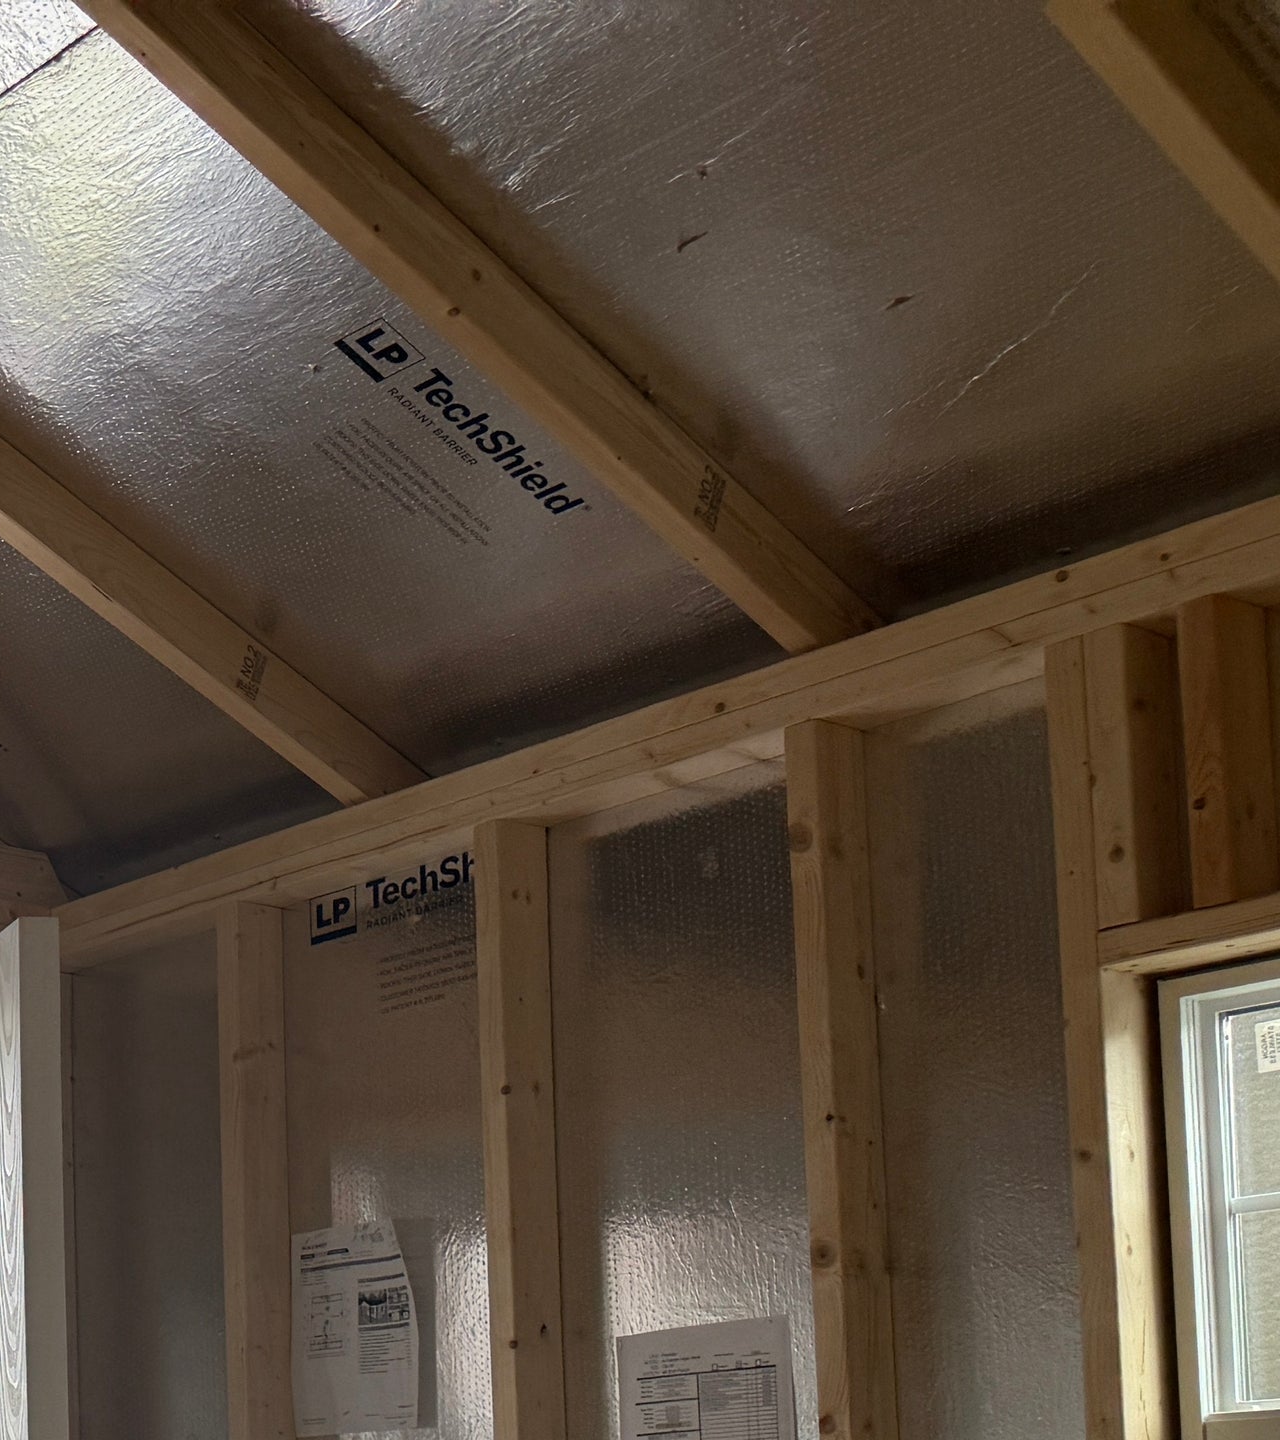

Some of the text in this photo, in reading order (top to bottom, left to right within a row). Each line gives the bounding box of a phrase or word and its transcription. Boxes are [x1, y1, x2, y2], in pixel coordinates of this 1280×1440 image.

[355, 327, 410, 367] LP
[413, 367, 585, 516] TechShield
[387, 386, 479, 466] RADIANT BARRIER
[315, 851, 474, 929] LP TechSh
[366, 908, 412, 929] RADIANT
